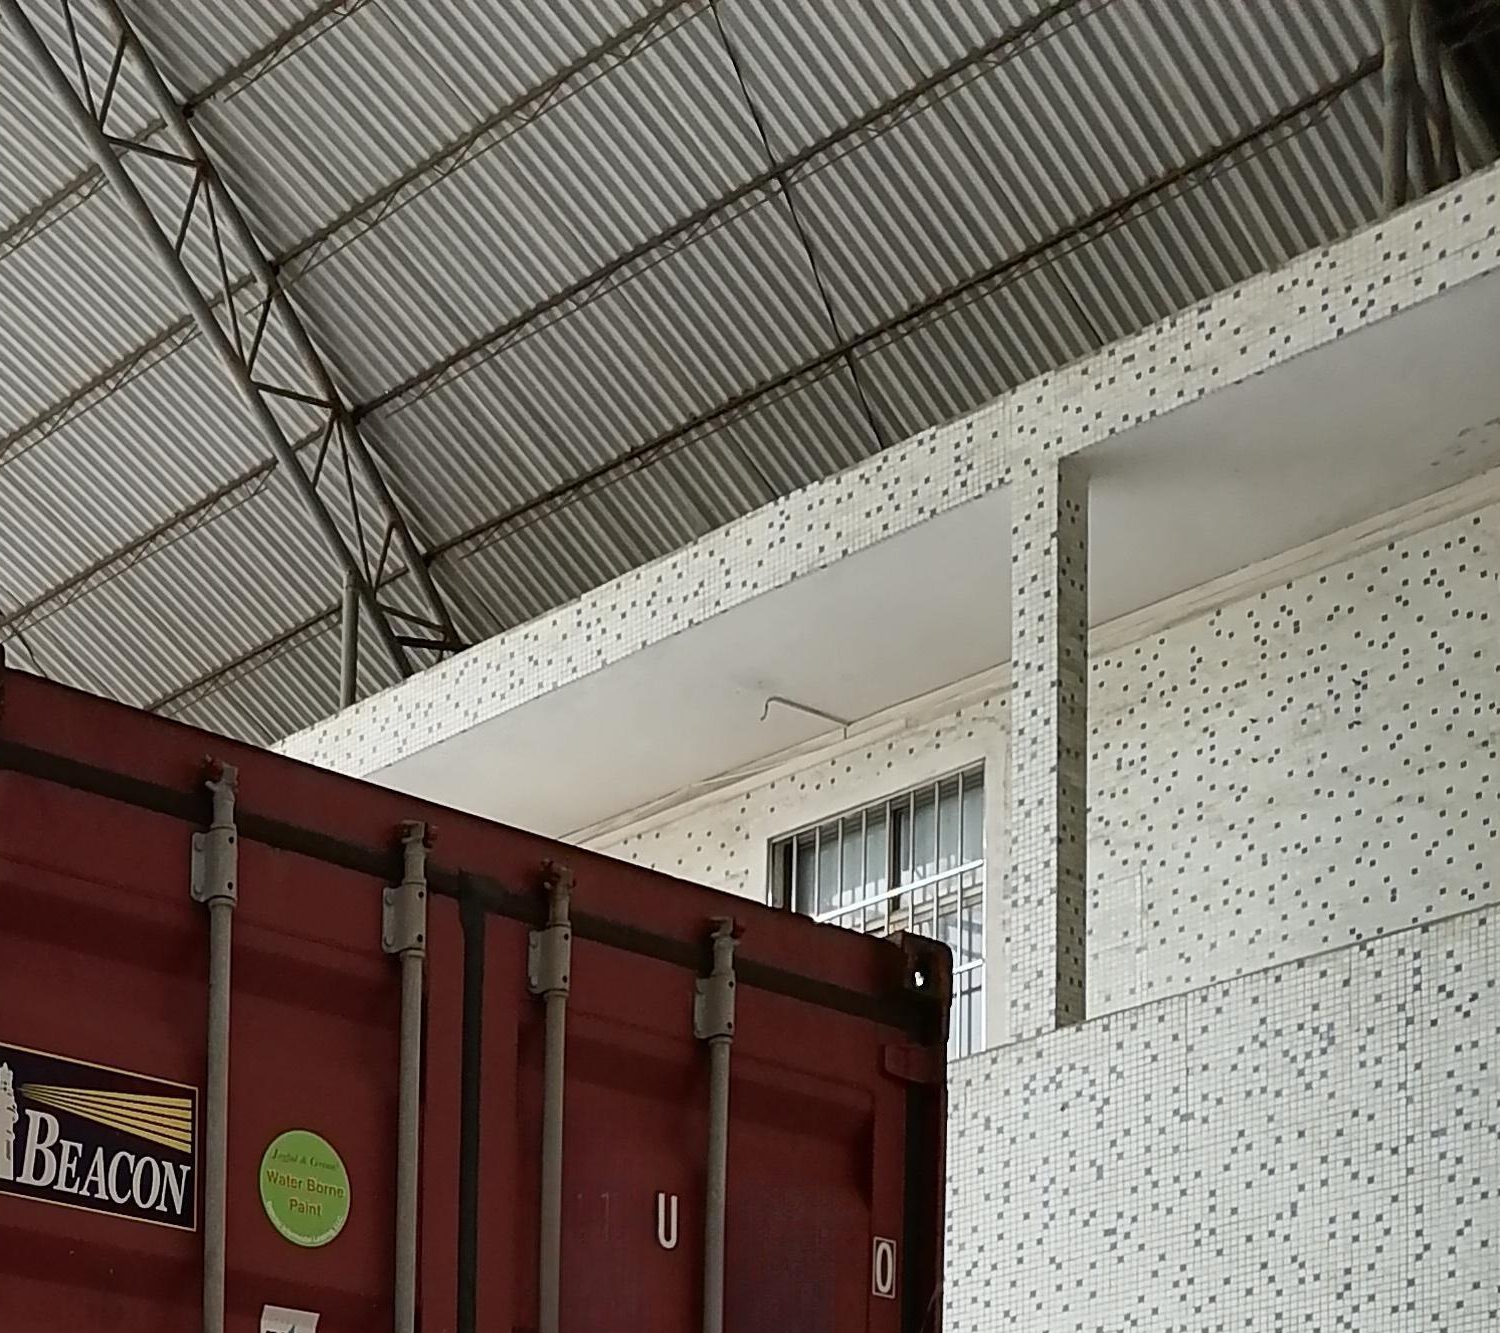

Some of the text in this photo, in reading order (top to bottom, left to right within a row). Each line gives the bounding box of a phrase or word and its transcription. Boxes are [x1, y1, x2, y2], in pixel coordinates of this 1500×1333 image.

[16, 1108, 190, 1215] BEACON
[266, 1169, 344, 1199] Water Borne
[289, 1198, 321, 1217] Paint
[657, 1192, 678, 1250] U
